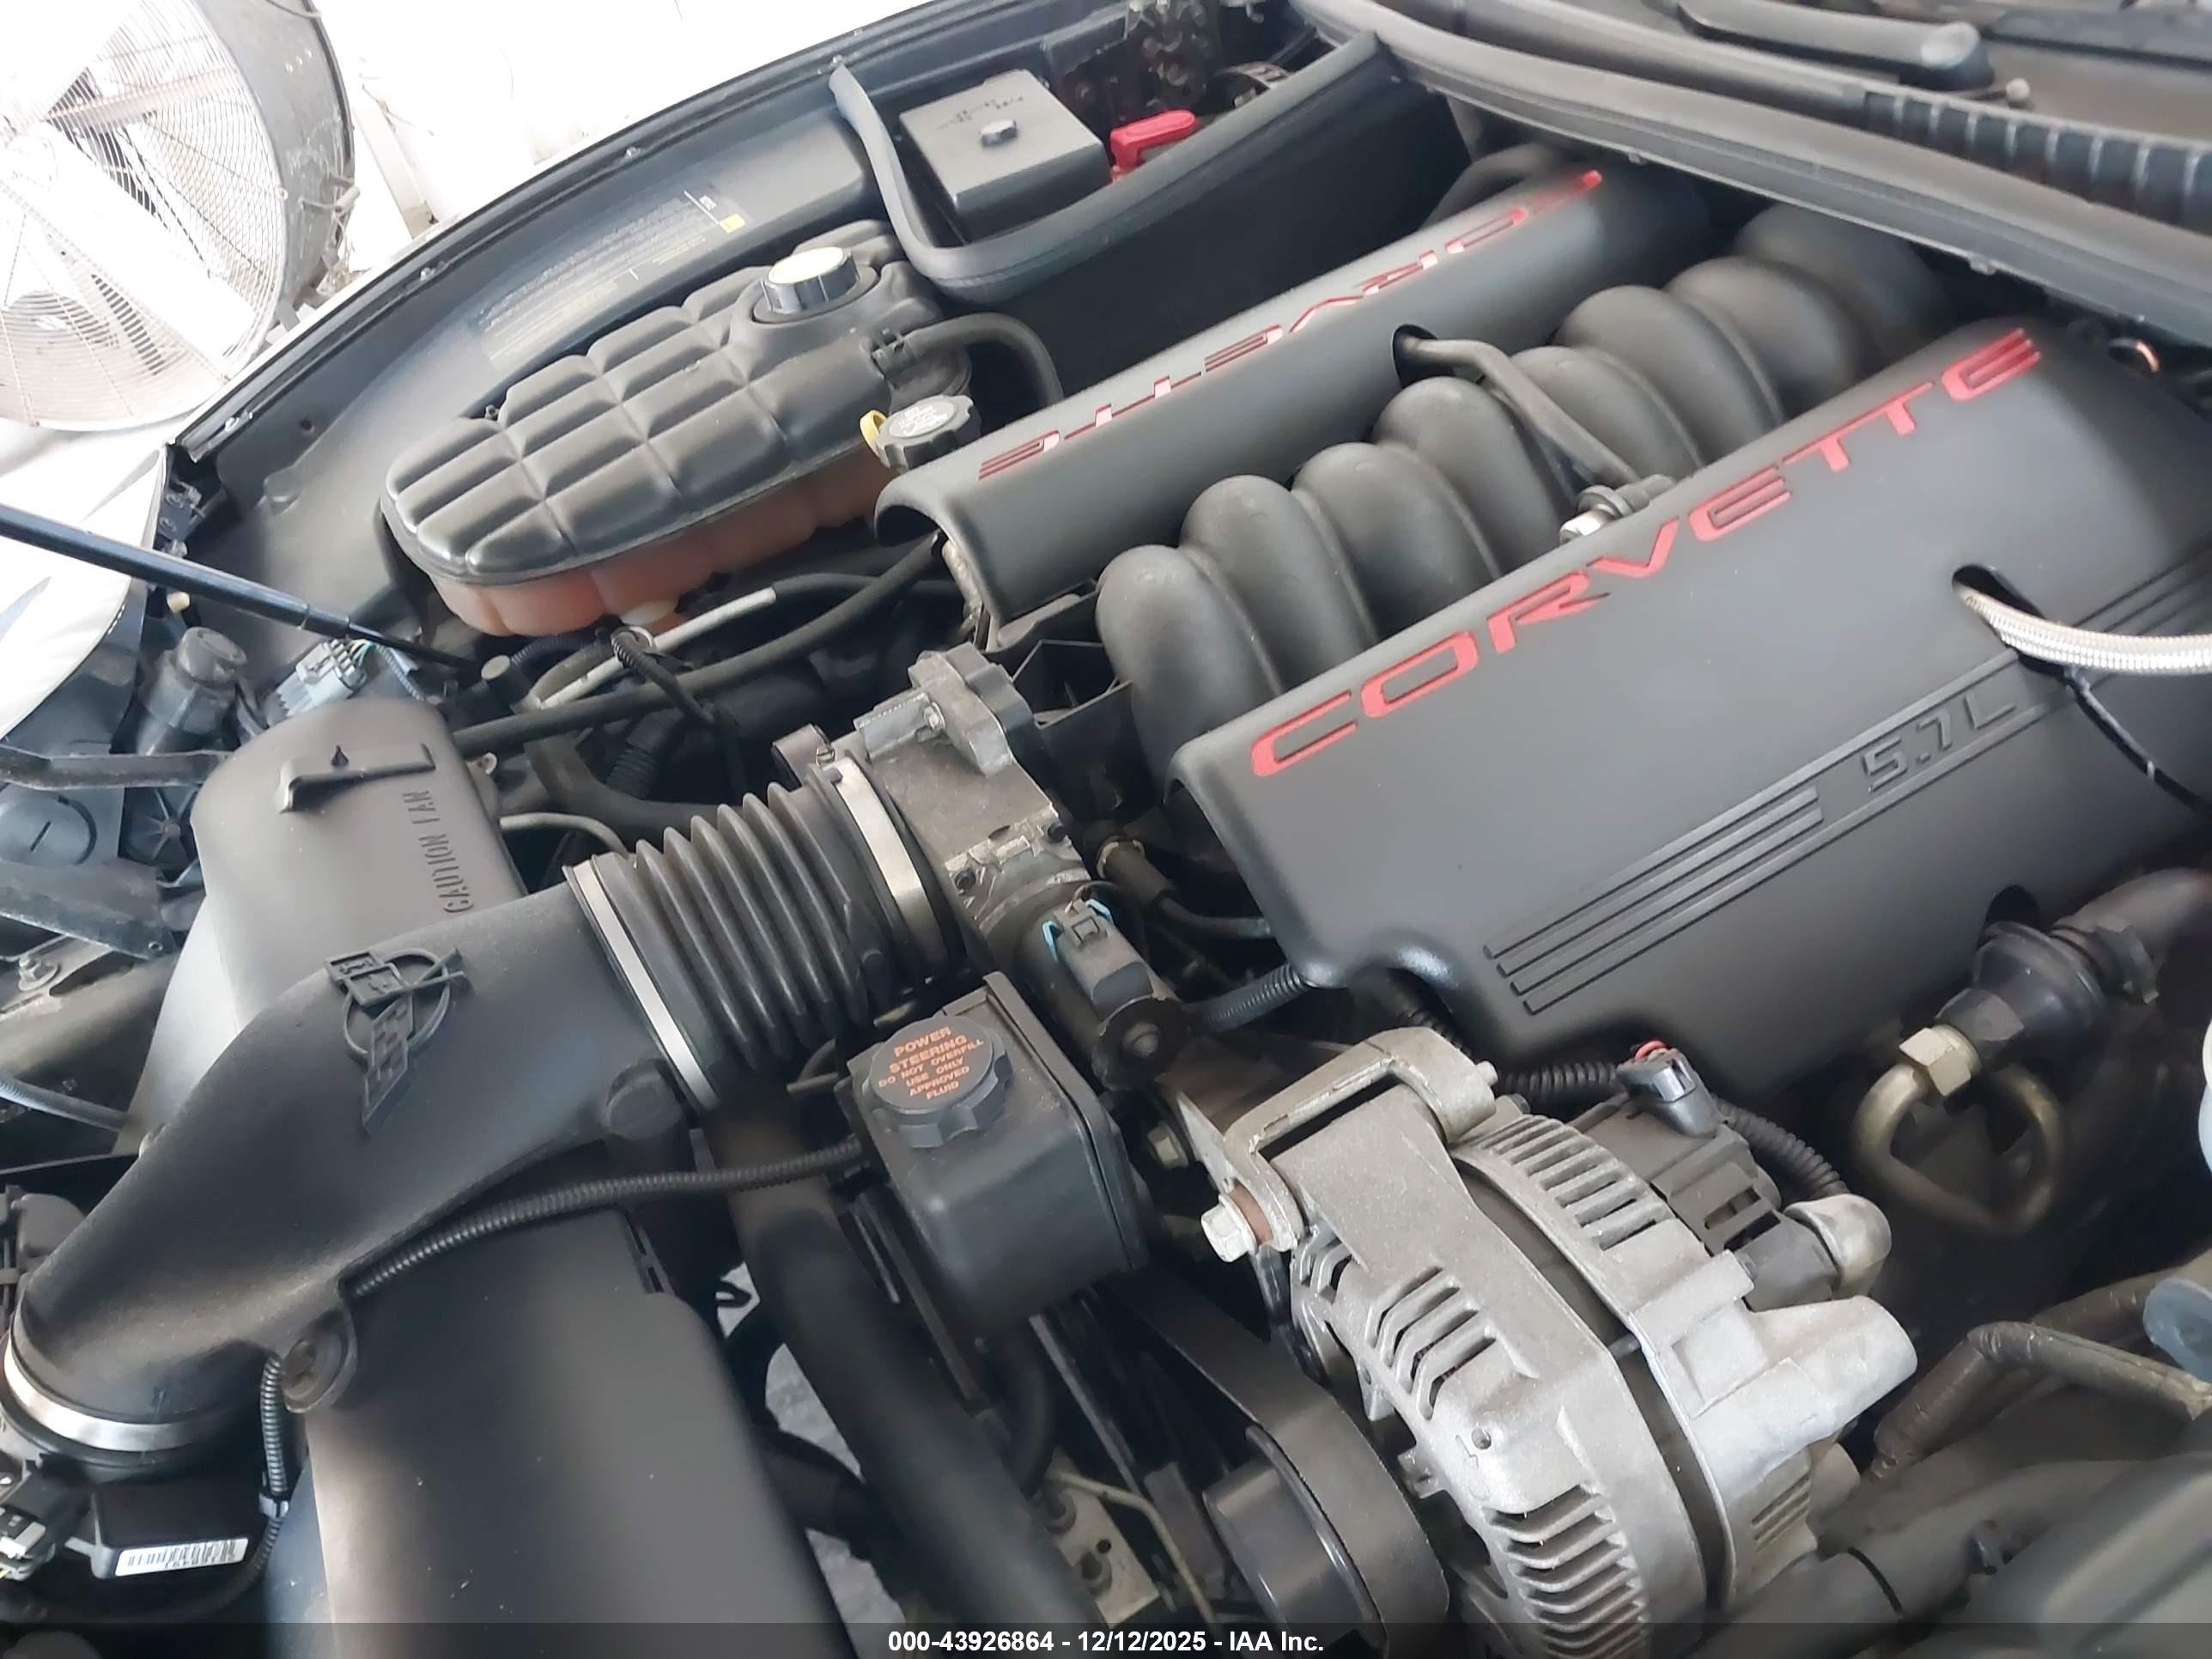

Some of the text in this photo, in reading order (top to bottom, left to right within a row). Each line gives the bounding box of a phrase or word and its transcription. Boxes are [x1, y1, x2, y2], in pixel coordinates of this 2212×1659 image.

[1250, 327, 2042, 777] CORVETTE
[1861, 691, 2017, 793] 5.7L
[418, 834, 474, 913] CAUTION
[889, 1034, 968, 1073] STEERING
[893, 1026, 951, 1057] POWER
[878, 1038, 984, 1088] DO NOT OVERFILL
[906, 1056, 964, 1087] USE ONLY
[909, 1065, 969, 1097] APPROVED
[926, 1081, 960, 1100] FLUID
